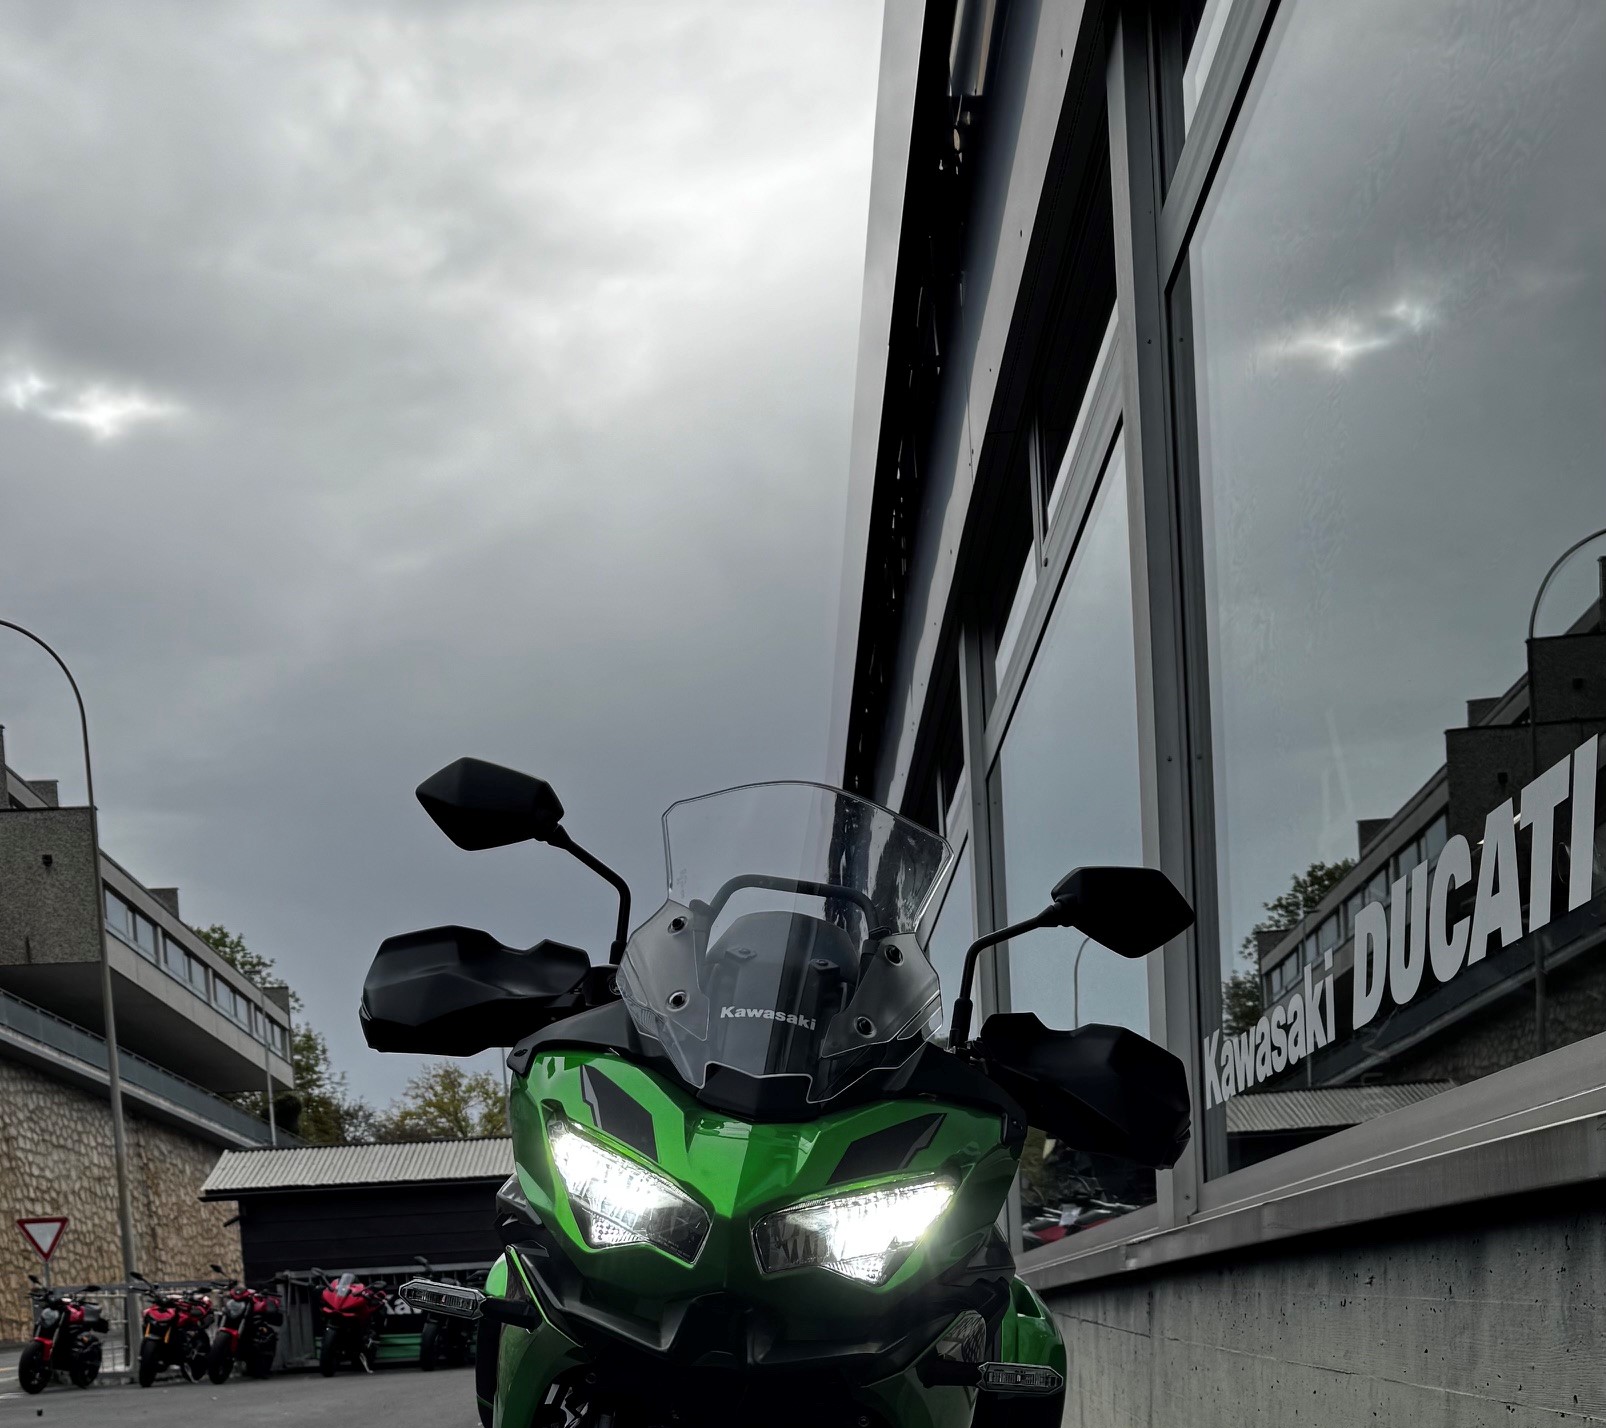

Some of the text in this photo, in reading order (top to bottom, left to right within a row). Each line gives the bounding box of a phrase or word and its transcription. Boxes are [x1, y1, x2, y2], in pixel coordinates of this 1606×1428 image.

[720, 1006, 816, 1031] Kawasaki
[1204, 733, 1598, 1110] Kawasaki DUCATI
